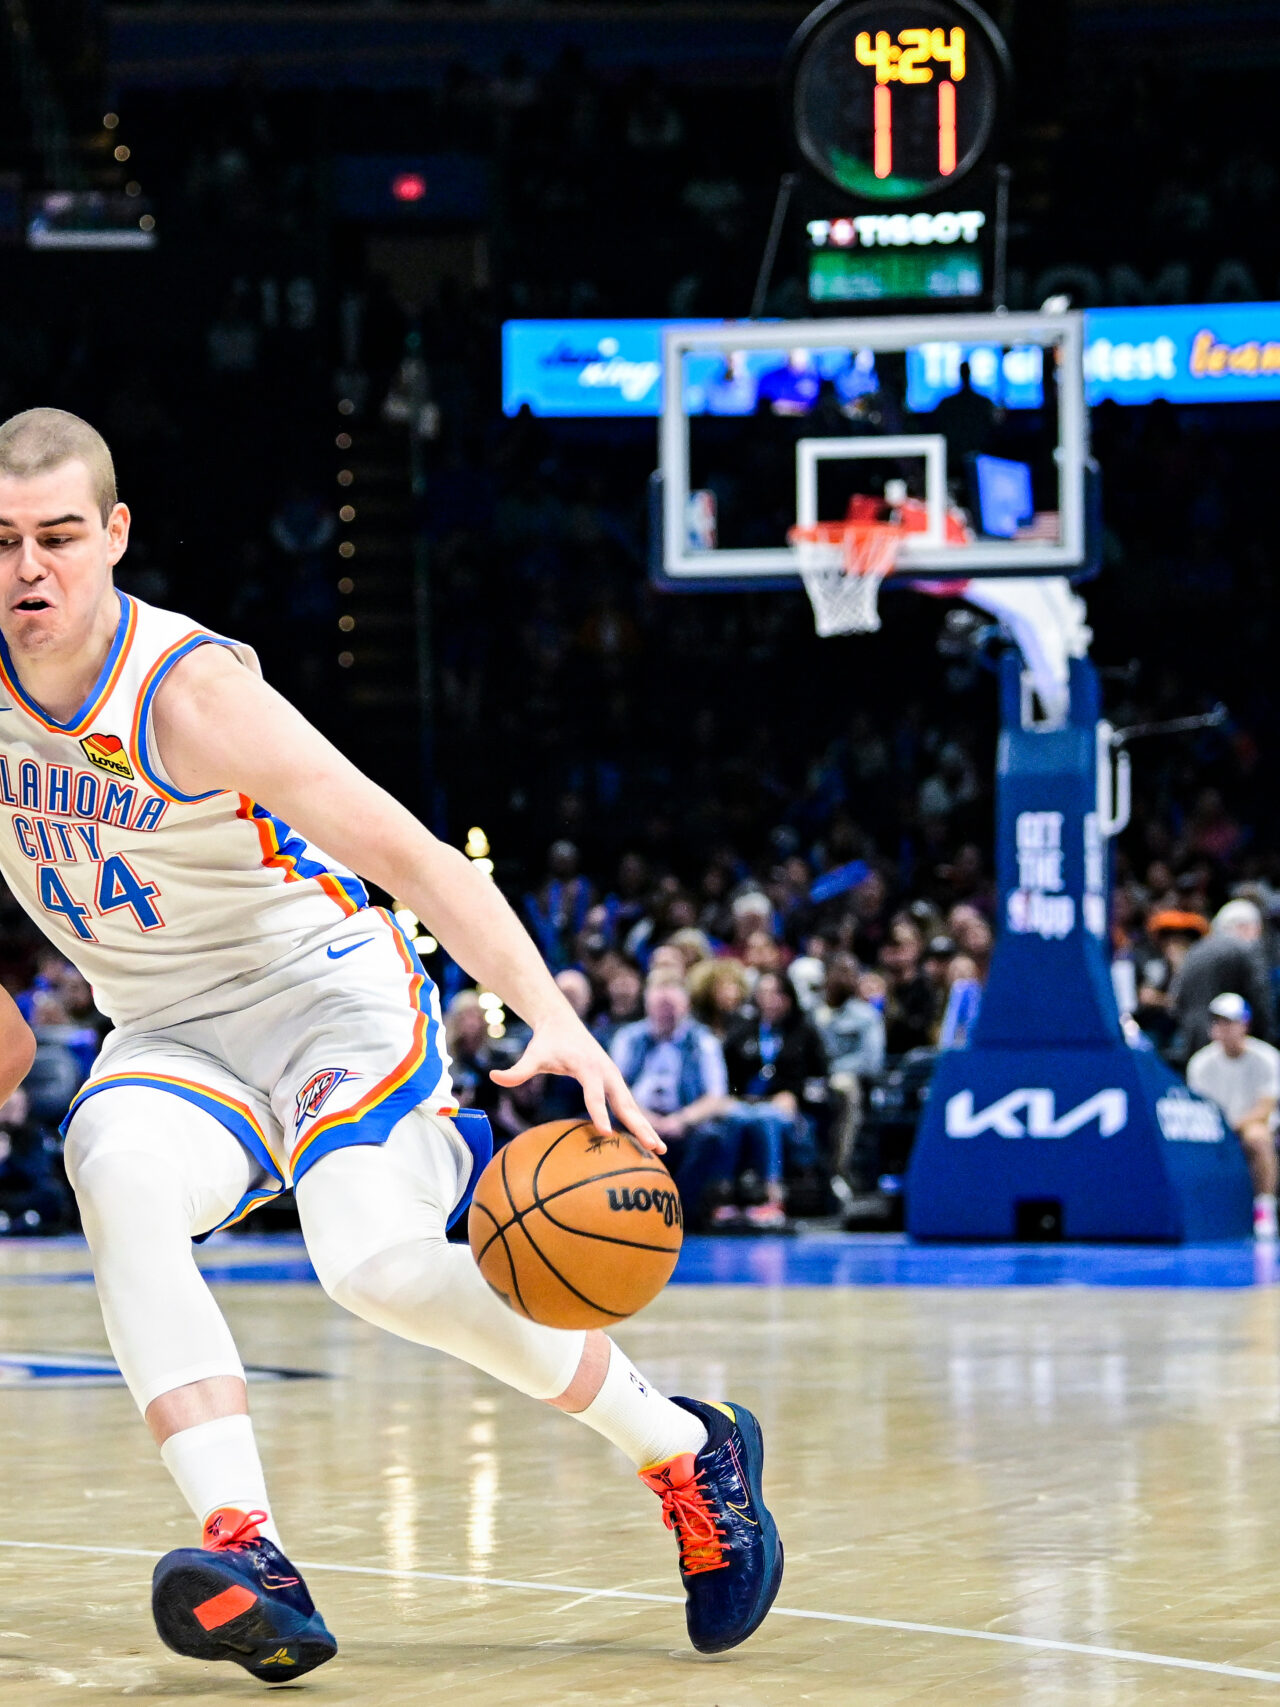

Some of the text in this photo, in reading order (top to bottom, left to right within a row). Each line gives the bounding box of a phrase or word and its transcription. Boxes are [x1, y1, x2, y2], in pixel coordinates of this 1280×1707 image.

[855, 26, 966, 85] 4:24
[873, 79, 957, 179] 11
[853, 210, 986, 247] TISSOT
[12, 813, 105, 863] CITY
[36, 851, 166, 943] 44
